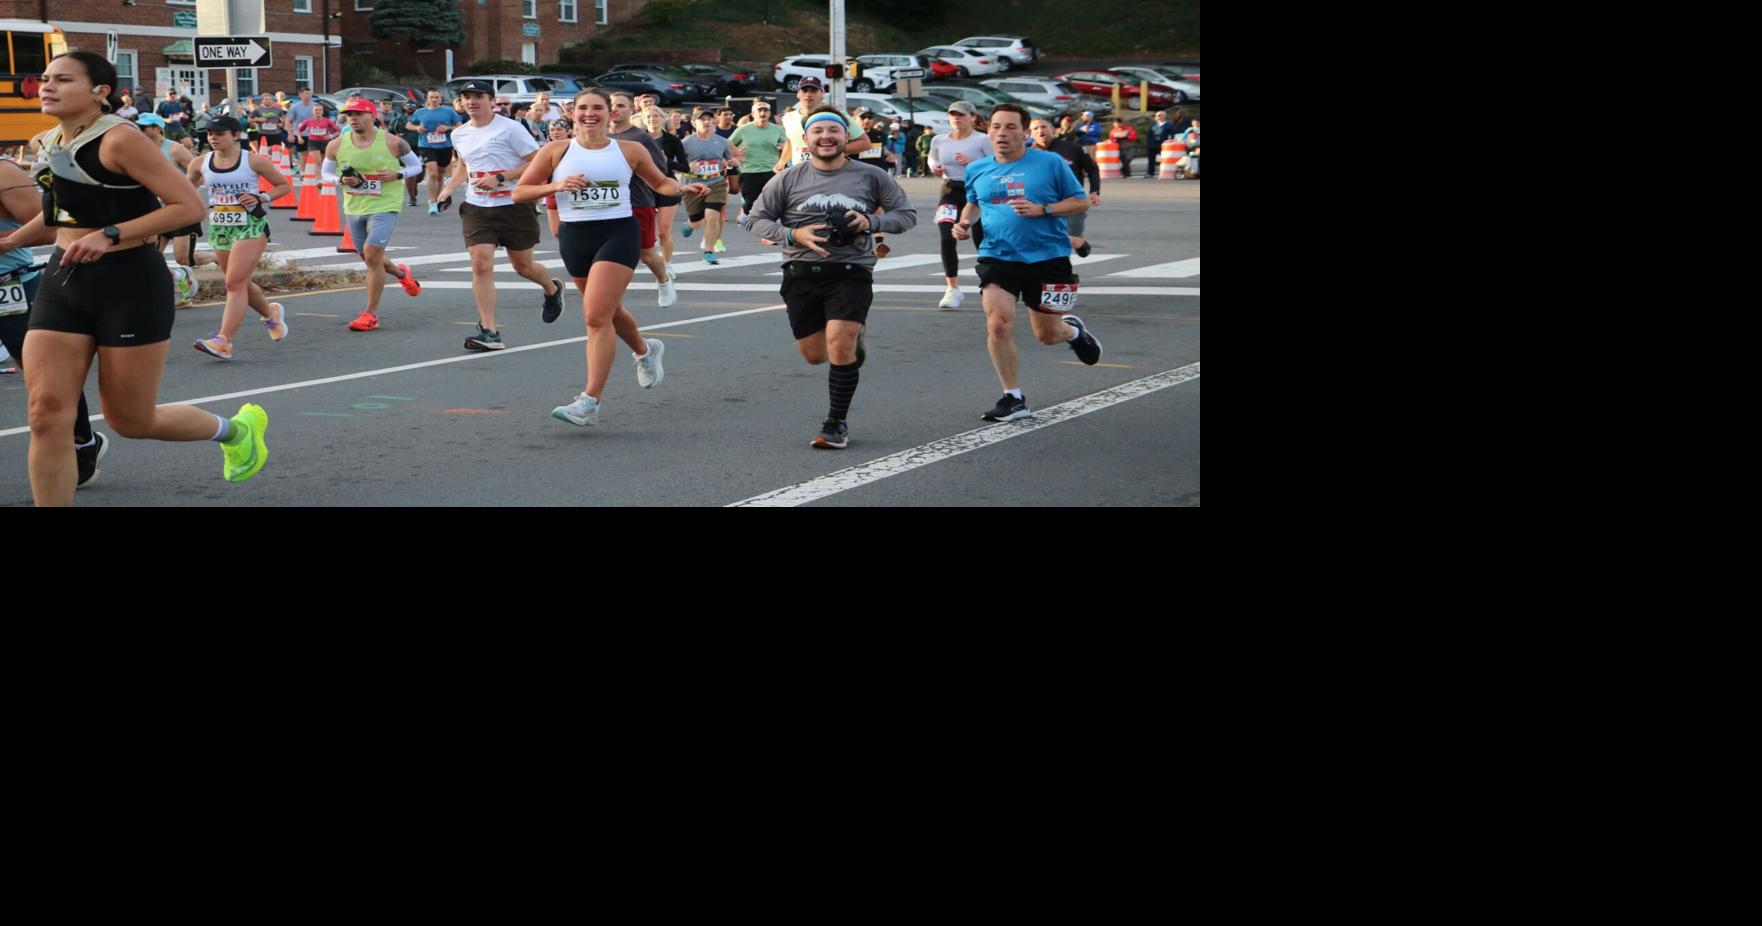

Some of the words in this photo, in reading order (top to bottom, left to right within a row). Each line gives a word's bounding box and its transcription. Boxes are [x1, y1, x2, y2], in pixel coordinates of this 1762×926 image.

[202, 46, 223, 58] ONE
[226, 46, 248, 58] WAY
[571, 187, 620, 201] 15370
[213, 212, 242, 223] 6952
